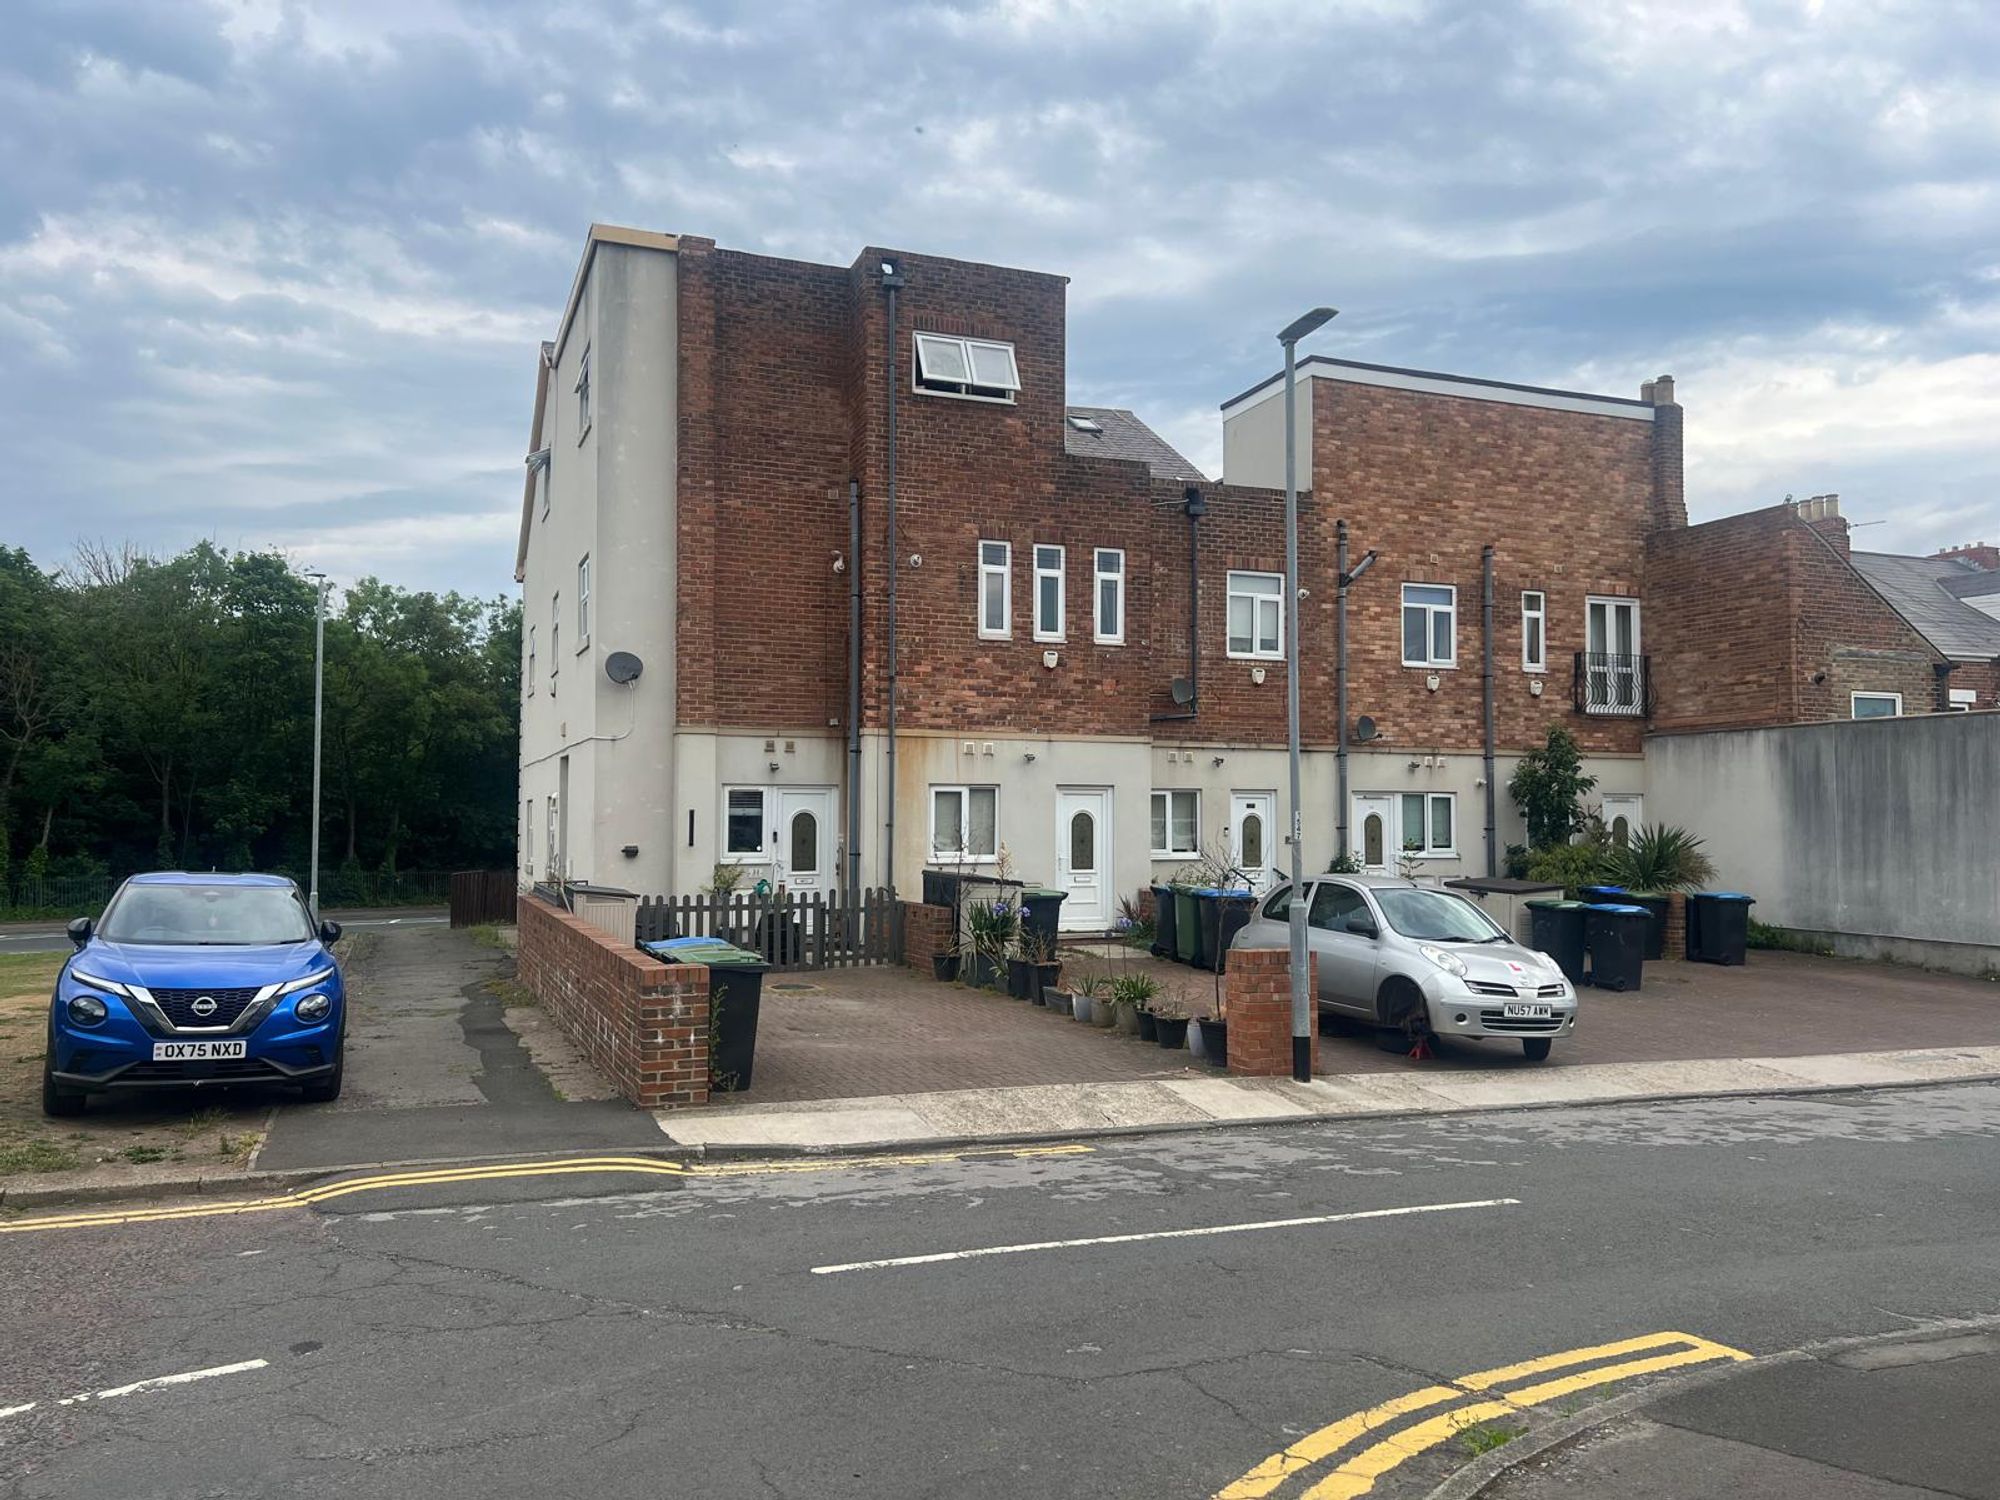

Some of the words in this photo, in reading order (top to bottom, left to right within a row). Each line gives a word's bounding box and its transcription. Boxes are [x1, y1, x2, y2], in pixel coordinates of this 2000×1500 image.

[1507, 1005, 1531, 1016] NU57
[165, 1044, 207, 1058] OX75
[211, 1043, 242, 1057] NXD
